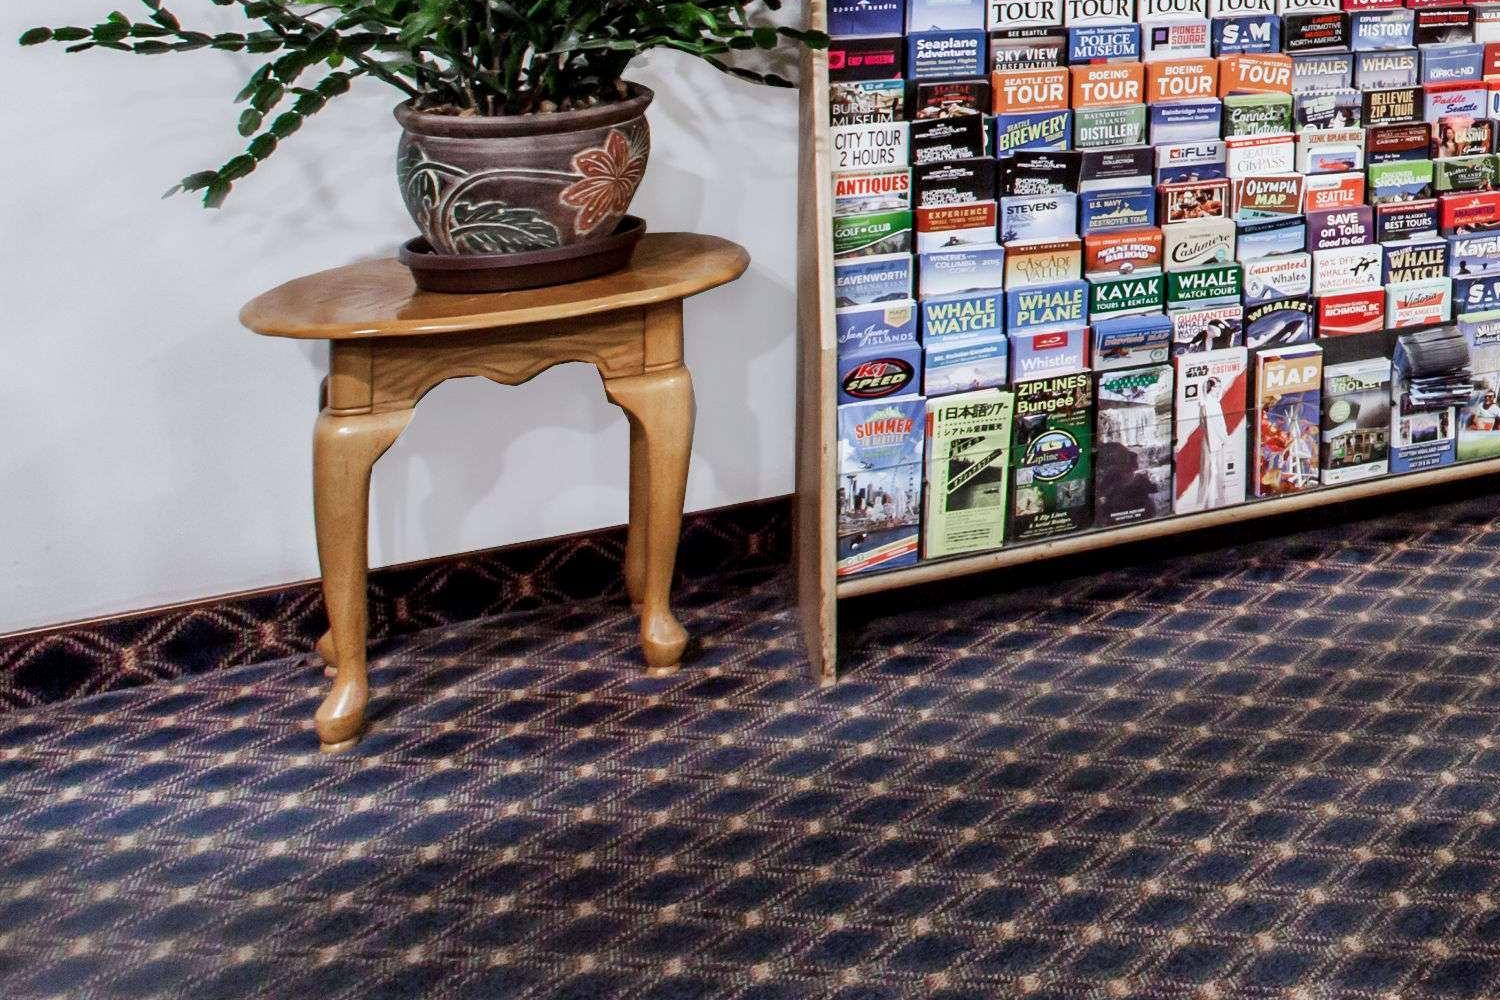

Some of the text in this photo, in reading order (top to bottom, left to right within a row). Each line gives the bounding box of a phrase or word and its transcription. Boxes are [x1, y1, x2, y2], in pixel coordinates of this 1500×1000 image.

[992, 1, 1055, 23] TOUR
[1022, 29, 1047, 37] SEATTLE
[1301, 22, 1342, 32] AUTOMOTIVE
[1358, 22, 1410, 37] HISTORY
[917, 38, 978, 50] Seaplane
[1080, 34, 1131, 47] POLICE
[1290, 36, 1342, 47] NORTH AMERICA
[917, 48, 977, 59] Adventures
[995, 48, 1059, 62] SKY VIEW
[1074, 44, 1135, 58] MUSEUM
[1165, 65, 1204, 75] BOEING
[1294, 62, 1348, 75] WHALES
[1362, 57, 1414, 71] WHALES
[1004, 75, 1064, 86] SEATTLE CITY
[1088, 70, 1128, 80] BOEING
[1238, 64, 1290, 85] TOUR
[1081, 81, 1138, 101] TOUR
[1157, 75, 1213, 95] TOUR
[1004, 84, 1064, 104] TOUR
[1371, 91, 1414, 105] BELLEVUE
[832, 103, 876, 114] BURKE
[1232, 108, 1277, 123] Connect
[1370, 103, 1413, 118] ZIP TOUR
[1445, 104, 1479, 114] Seattle
[832, 115, 893, 126] MUSEUM
[999, 113, 1068, 149] BREWERY
[1080, 123, 1140, 140] DISTILLERY
[835, 130, 901, 150] CITY TOUR
[839, 149, 895, 167] 2 HOURS
[1181, 145, 1217, 158] iFLY
[835, 175, 909, 195] ANTIQUES
[1246, 180, 1298, 196] OLYMPIA
[1255, 195, 1286, 206] MAP
[1315, 189, 1355, 202] SEATTLE
[1006, 201, 1057, 215] STEVENS
[1090, 200, 1121, 209] U.S. NAVY
[928, 208, 988, 219] EXPERIENCE
[1327, 212, 1358, 226] SAVE
[835, 222, 891, 238] GOLF CLUB
[1321, 224, 1365, 238] on Tolls
[1384, 218, 1432, 230] BEST TOURS
[1129, 245, 1156, 253] HOOD
[1171, 233, 1230, 262] Cashmere
[1318, 237, 1350, 248] Good To
[929, 254, 966, 263] WINERIES
[1016, 255, 1071, 272] CASCADE
[1104, 251, 1148, 263] RAILROAD
[1390, 250, 1445, 268] WHALE
[1249, 259, 1307, 275] Guaranteed
[1319, 268, 1348, 278] WHALE
[1388, 265, 1444, 283] WATCH
[837, 270, 907, 287] EAVENWORTH
[1178, 269, 1237, 289] WHALE
[1272, 273, 1306, 285] Whales
[1096, 278, 1158, 301] KAYAK
[1178, 286, 1236, 299] WATCH TOURS
[1018, 289, 1083, 310] WHALE
[1096, 302, 1119, 310] TOURS
[1128, 297, 1158, 307] RENTALS
[1404, 290, 1437, 307] Victoria
[927, 298, 995, 320] WHALE
[1368, 302, 1380, 311] BC
[1016, 304, 1081, 327] PLANE
[1177, 308, 1241, 323] GUARANTEED
[927, 313, 995, 336] WATCH
[839, 324, 890, 347] San Juan
[866, 332, 913, 344] ISLANDS
[1021, 355, 1078, 370] Whistler
[1186, 365, 1208, 373] STAR
[1212, 363, 1240, 374] COSTUME
[1185, 370, 1208, 378] WARS
[1267, 366, 1316, 390] MAP
[845, 374, 907, 391] SPEED
[1018, 375, 1087, 396] ZIPLINES
[946, 403, 1008, 420] 日本語ツアー
[1017, 396, 1074, 414] Bungee
[855, 419, 913, 438] SUMMER
